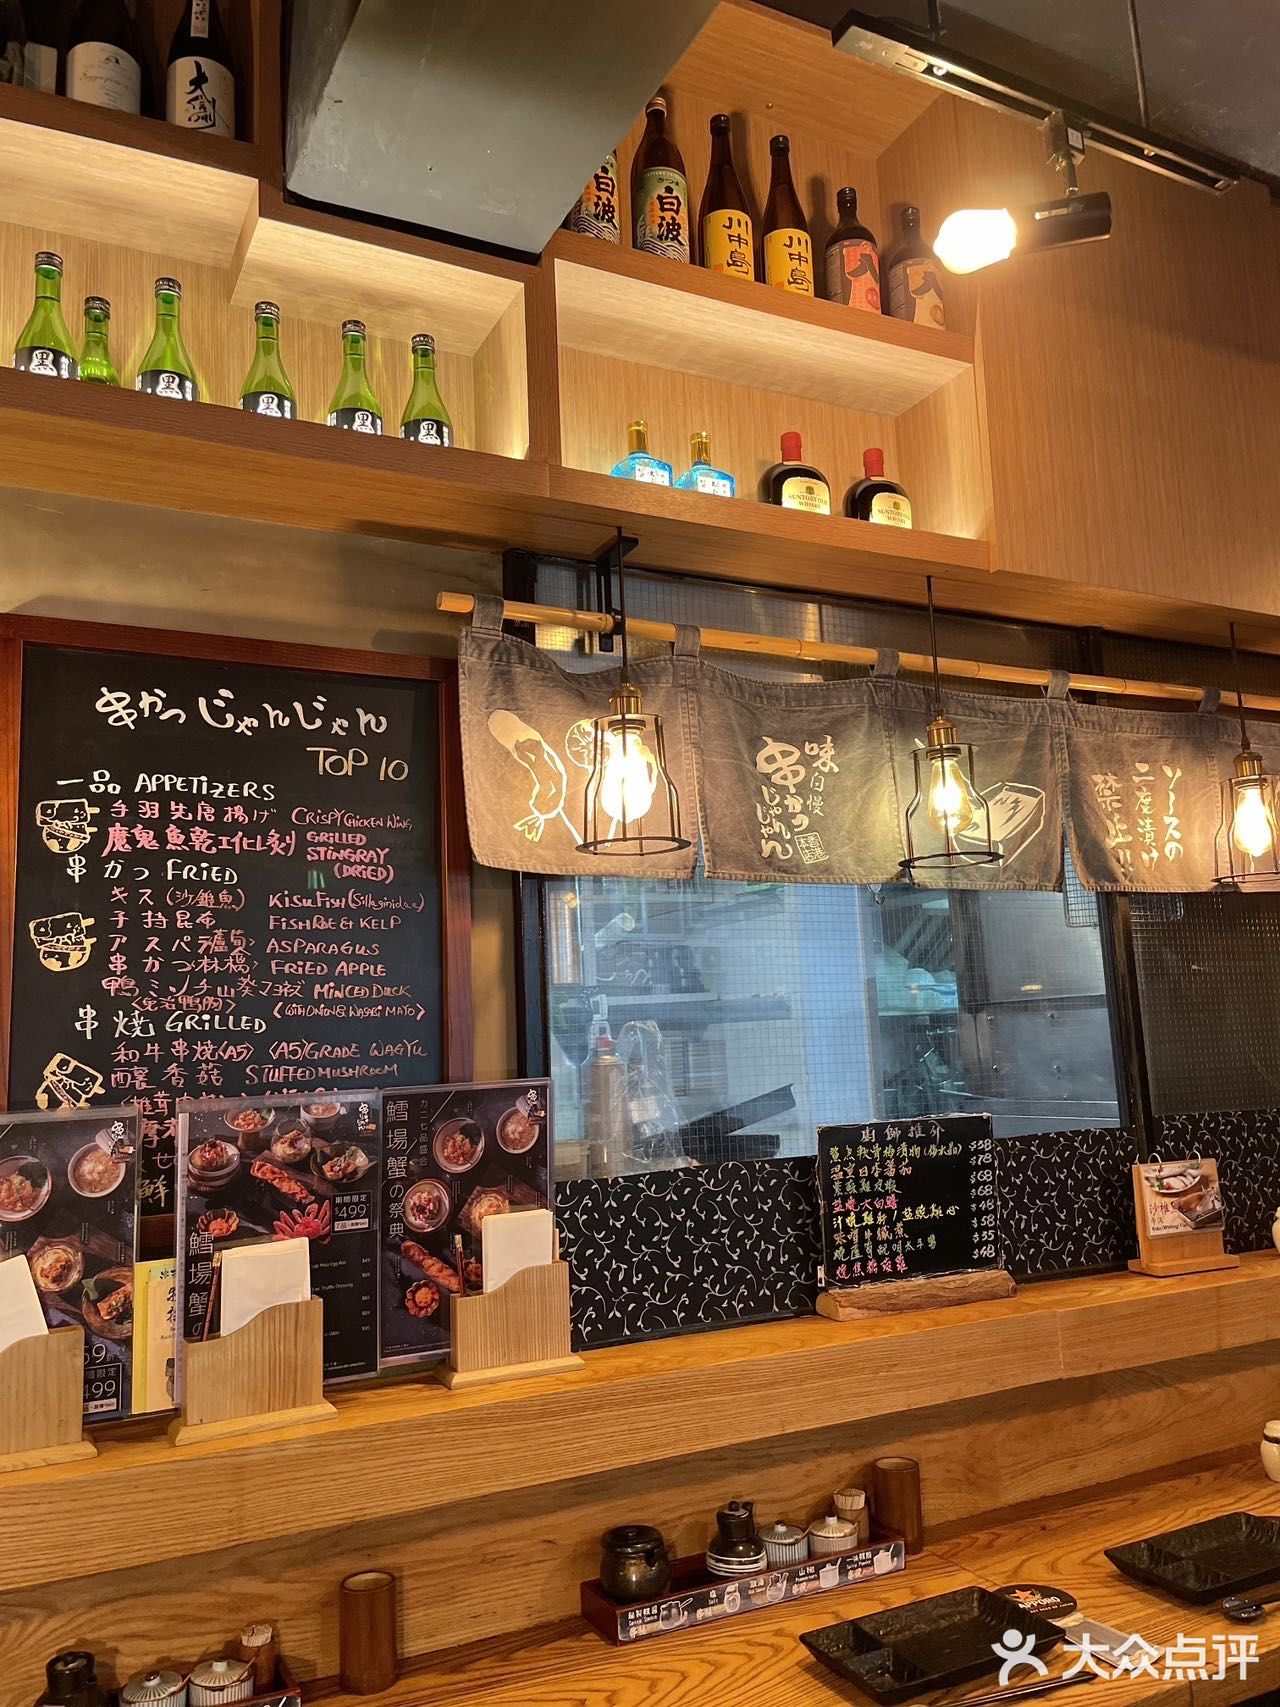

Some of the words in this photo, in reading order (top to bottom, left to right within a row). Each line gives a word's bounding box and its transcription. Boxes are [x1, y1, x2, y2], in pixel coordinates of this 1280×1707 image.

[593, 165, 617, 229] 白波
[656, 185, 685, 246] 白波
[722, 216, 752, 276] 川中島
[783, 235, 812, 292] 川中島
[306, 747, 368, 777] TOP
[379, 757, 410, 781] 10
[804, 734, 840, 817] 味自慢
[56, 769, 121, 795] 一品
[755, 736, 810, 832] 串かつ
[1132, 762, 1160, 872] 二度漬け
[1161, 764, 1184, 862] ソースの
[109, 910, 217, 930] 子持昆布
[360, 915, 402, 930] KELP
[335, 960, 388, 977] APPLE
[245, 1064, 316, 1085] STUFFED
[386, 1100, 409, 1237] 鱈場蟹の祭典
[969, 1152, 993, 1166] $78
[970, 1169, 993, 1184] $68
[970, 1184, 993, 1199] $68
[971, 1213, 996, 1228] $58
[972, 1229, 996, 1244] $35
[972, 1243, 996, 1259] $48
[1017, 1596, 1061, 1609] APPORO
